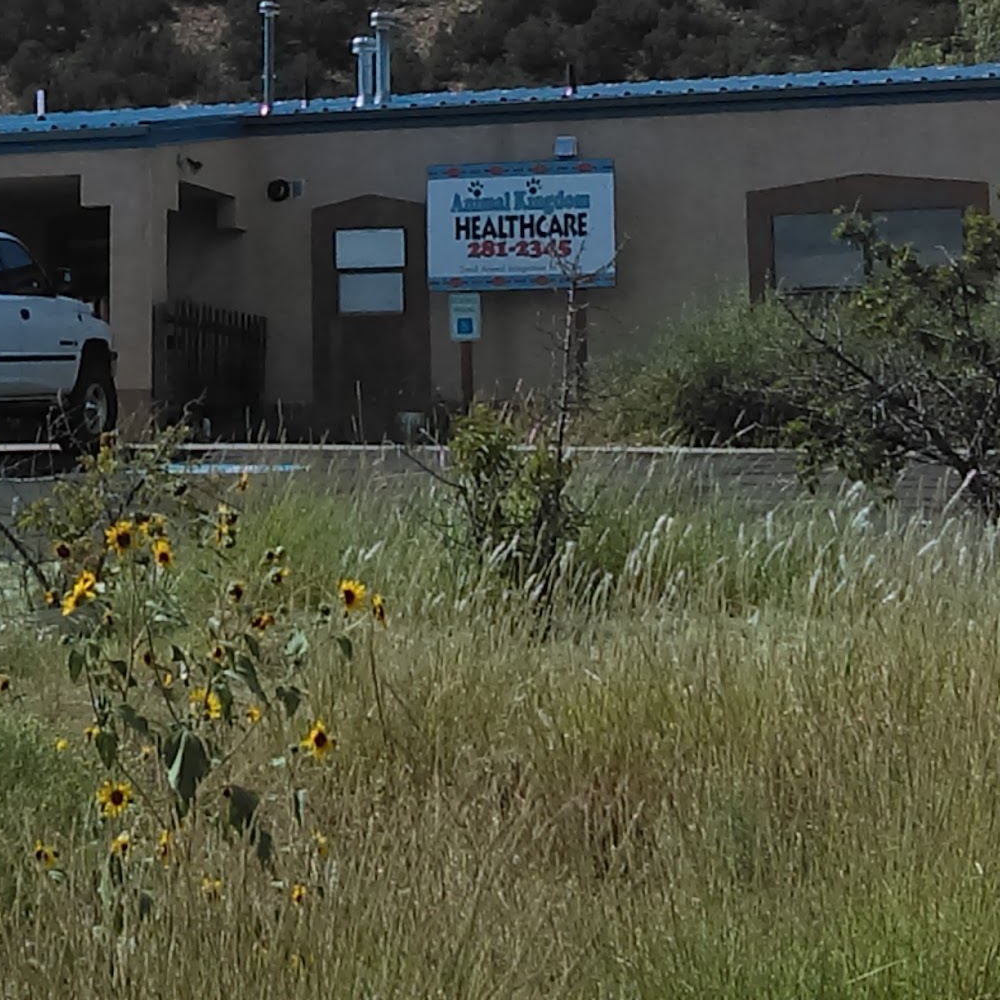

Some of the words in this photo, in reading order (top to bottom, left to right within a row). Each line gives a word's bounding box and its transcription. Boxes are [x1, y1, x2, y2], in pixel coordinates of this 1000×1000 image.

[450, 192, 510, 213] Animal
[514, 190, 590, 214] Kingdom
[455, 213, 588, 240] HEALTHCARE
[467, 240, 572, 258] 281-2345
